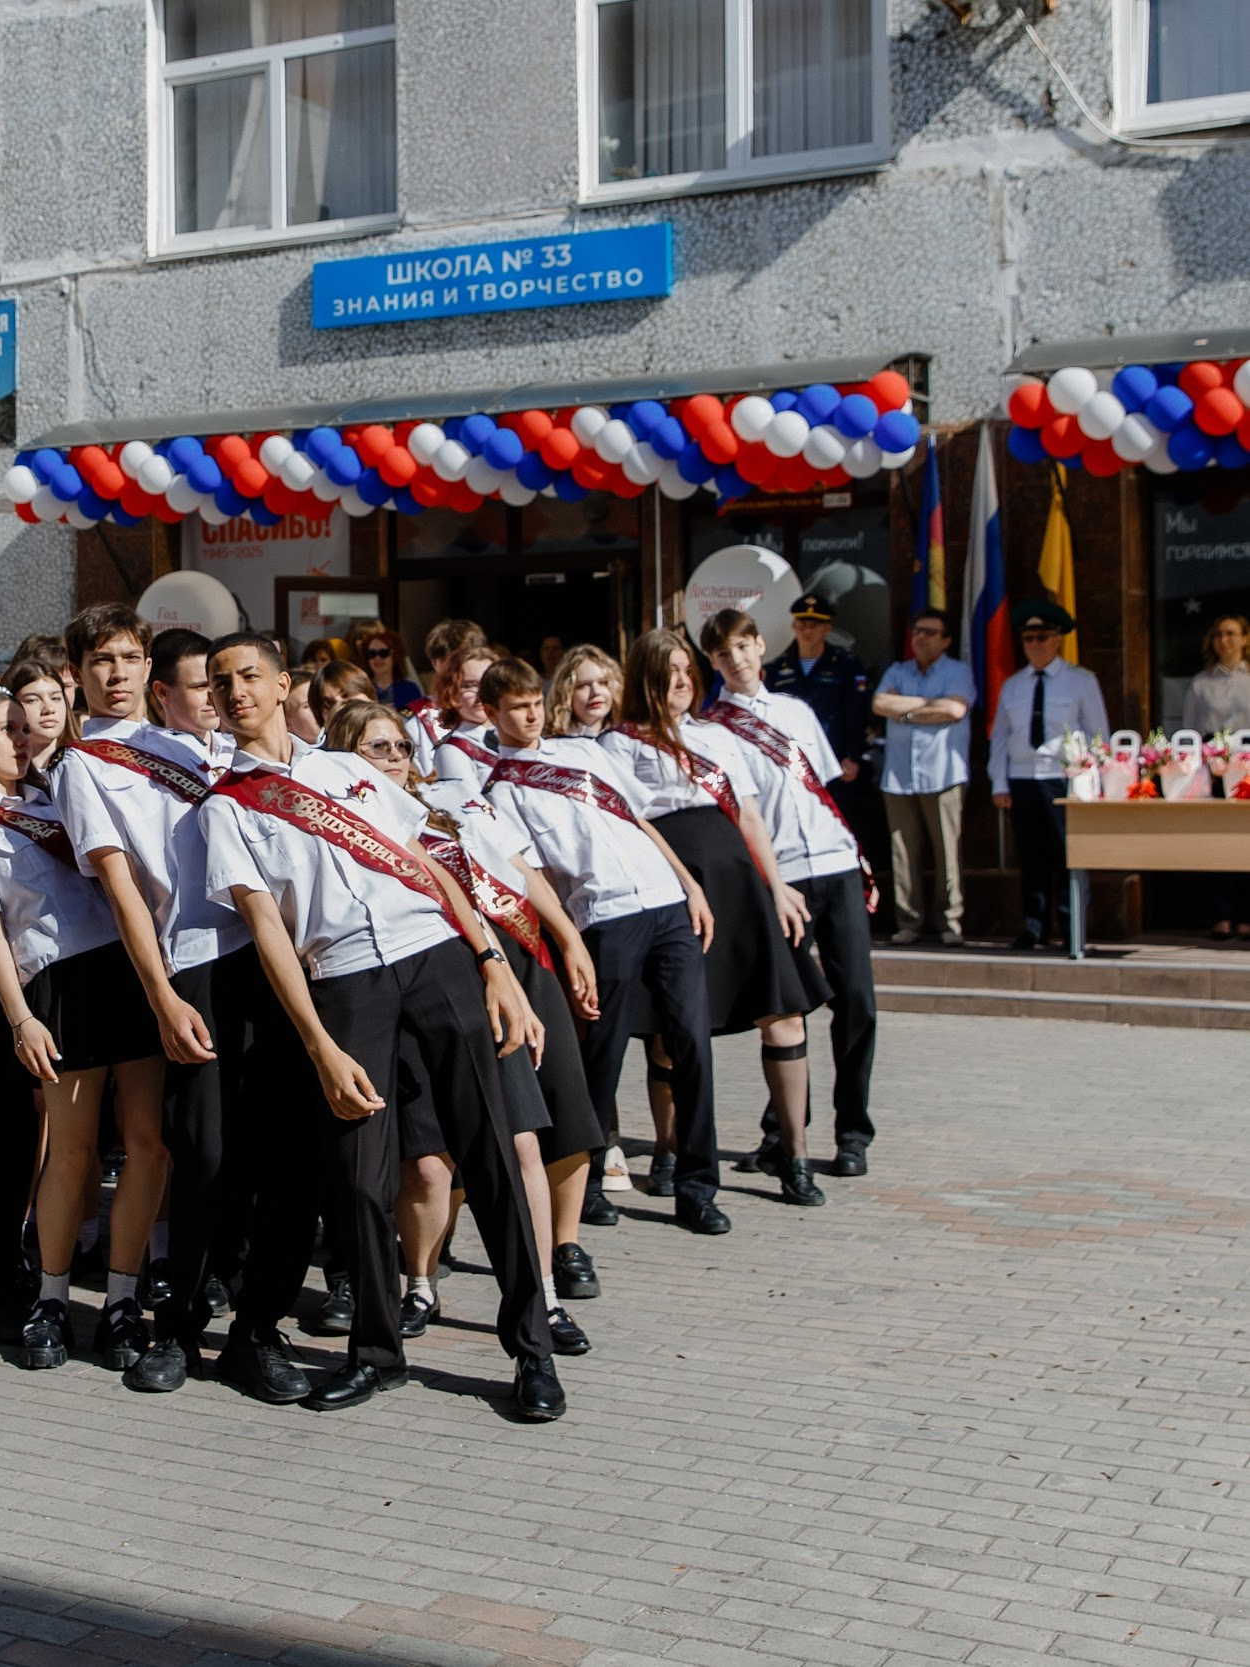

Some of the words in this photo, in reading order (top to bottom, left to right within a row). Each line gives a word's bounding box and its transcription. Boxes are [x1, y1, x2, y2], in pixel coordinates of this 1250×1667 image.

[386, 252, 493, 286] ШКОЛА
[502, 247, 534, 272] №
[541, 243, 572, 268] 33
[332, 289, 435, 317] ЗНАНИЯ
[443, 286, 459, 305] И
[466, 267, 644, 302] ТВОРЧЕСТВО
